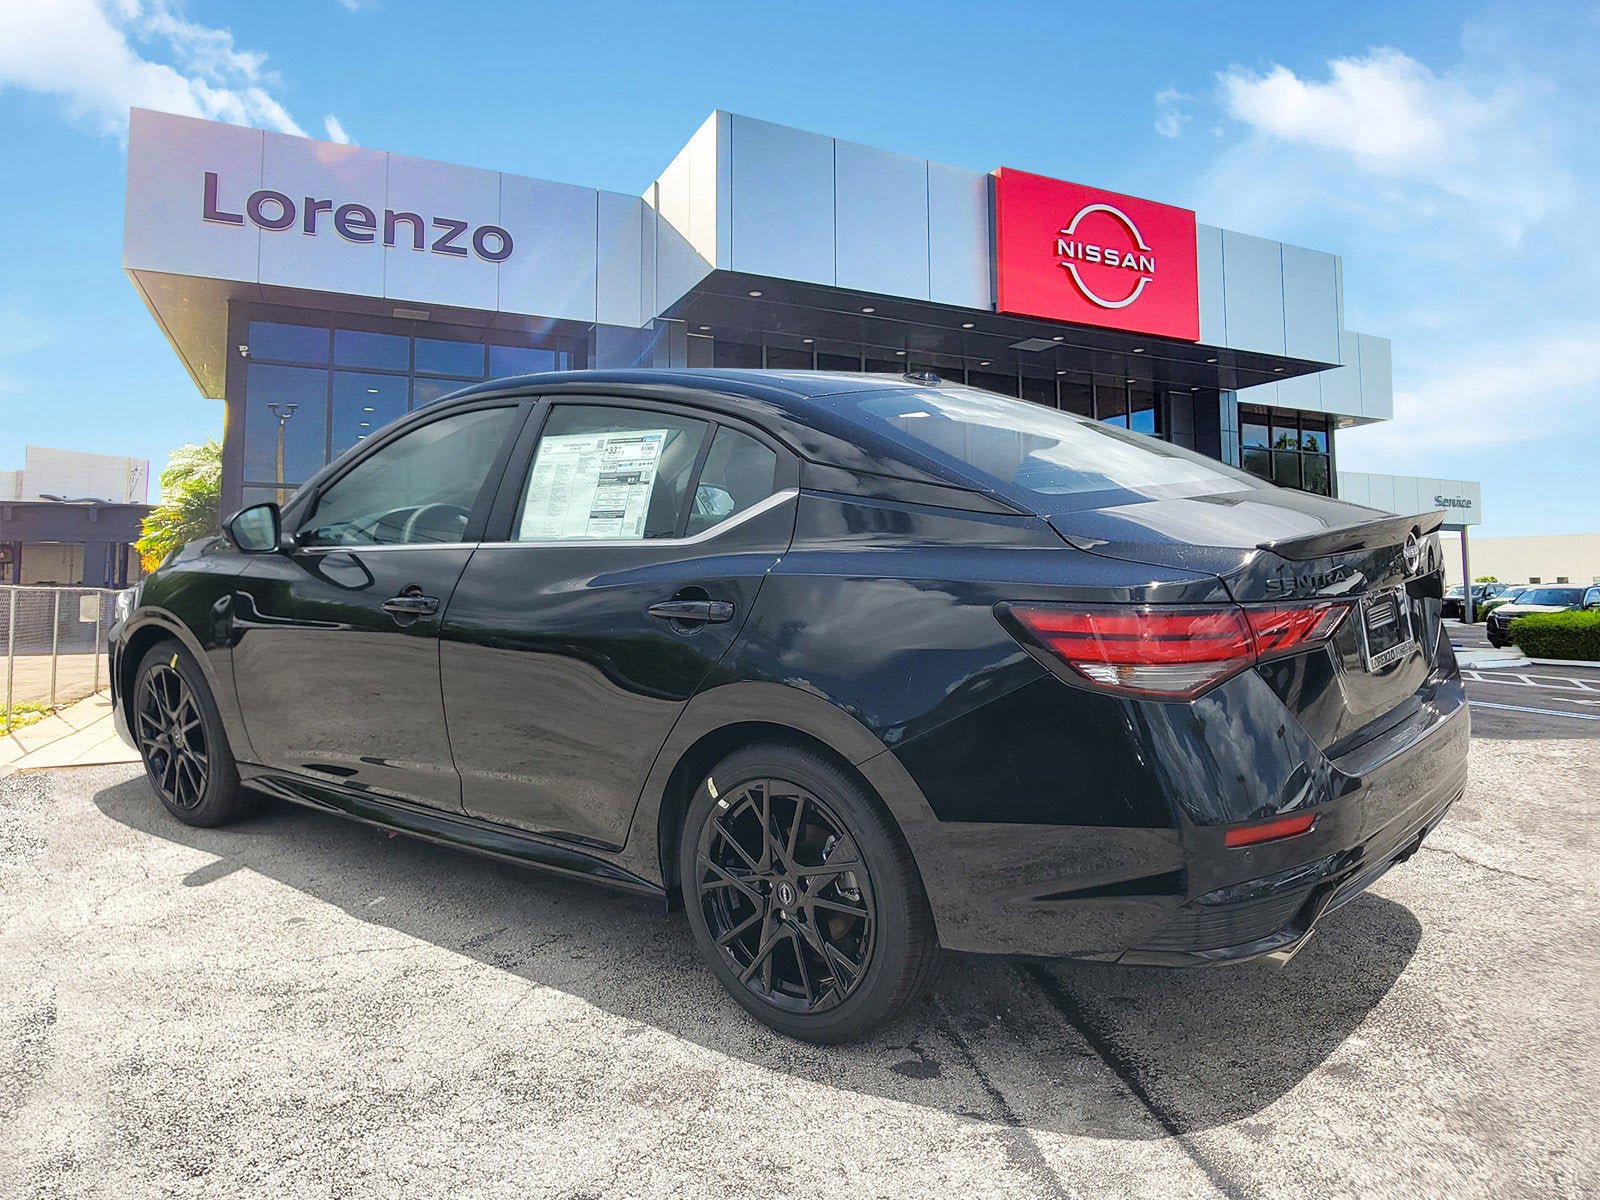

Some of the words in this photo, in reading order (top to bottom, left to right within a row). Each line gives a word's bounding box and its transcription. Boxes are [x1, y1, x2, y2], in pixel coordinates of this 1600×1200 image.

[203, 171, 514, 263] Lorenzo
[1057, 238, 1155, 273] NISSAN
[1434, 495, 1472, 508] Service
[1265, 569, 1347, 593] SENTRA
